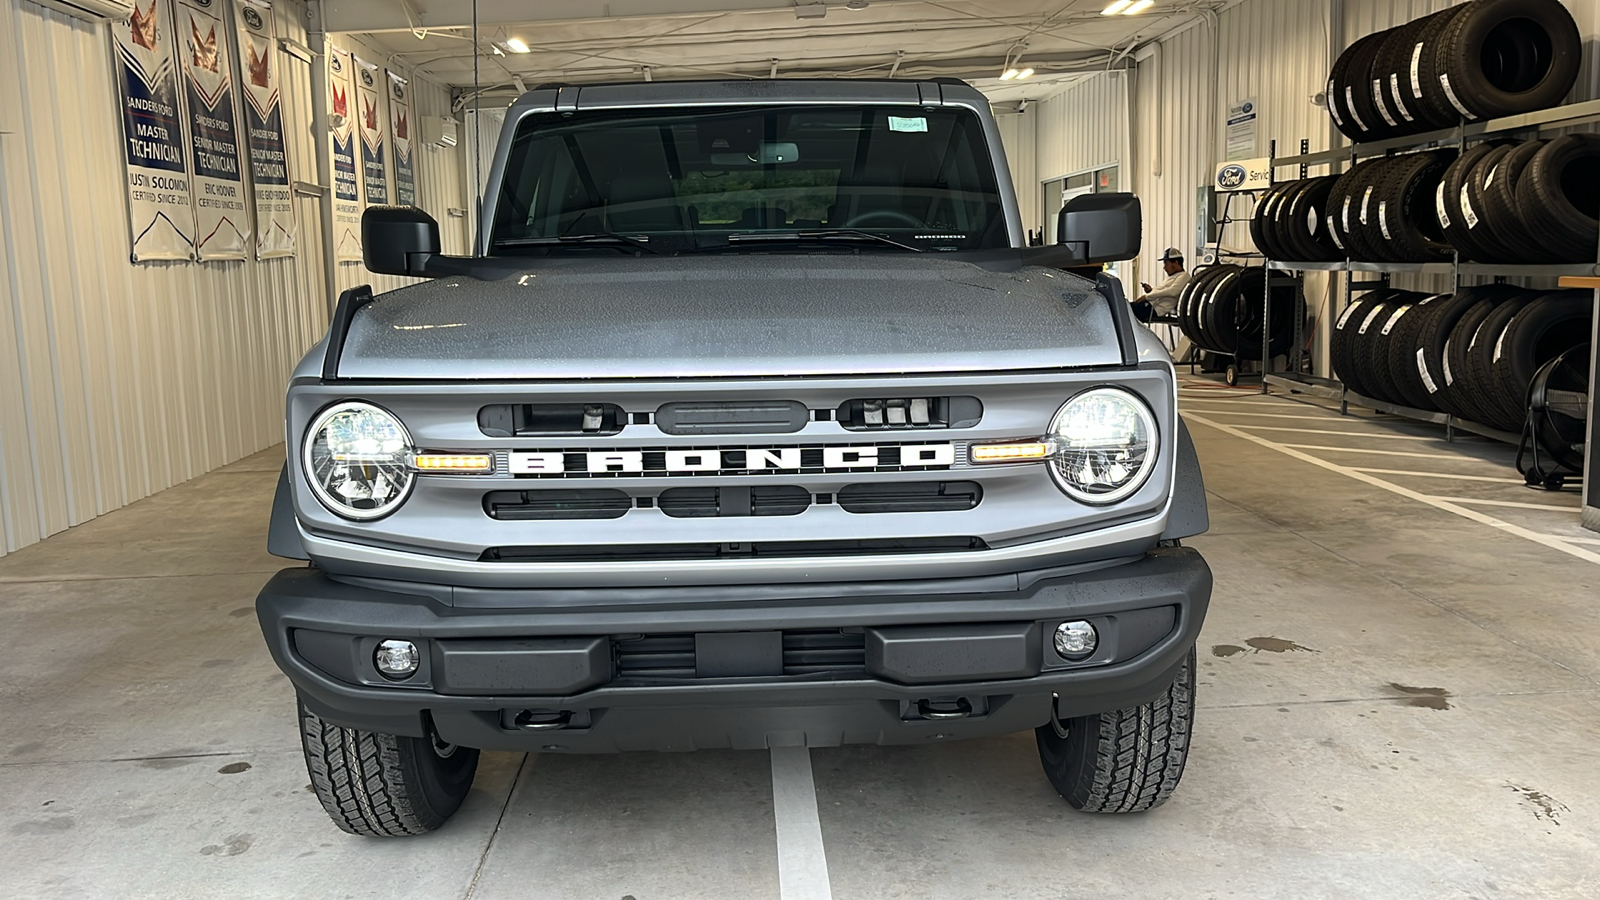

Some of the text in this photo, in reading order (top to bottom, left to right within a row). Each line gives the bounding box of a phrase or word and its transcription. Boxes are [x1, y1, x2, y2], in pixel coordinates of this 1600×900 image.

[127, 96, 173, 117] SANDERS FORD
[137, 123, 169, 141] MASTER
[216, 119, 229, 131] FORD
[129, 138, 181, 164] TECHNICIAN
[214, 140, 236, 155] MASTER
[197, 151, 237, 173] TECHNICIAN
[152, 176, 188, 192] SOLOMON
[1221, 167, 1242, 186] Ford
[157, 193, 176, 204] SINCE
[205, 183, 236, 198] ERIC HOOVER
[508, 444, 955, 474] BRONCO
